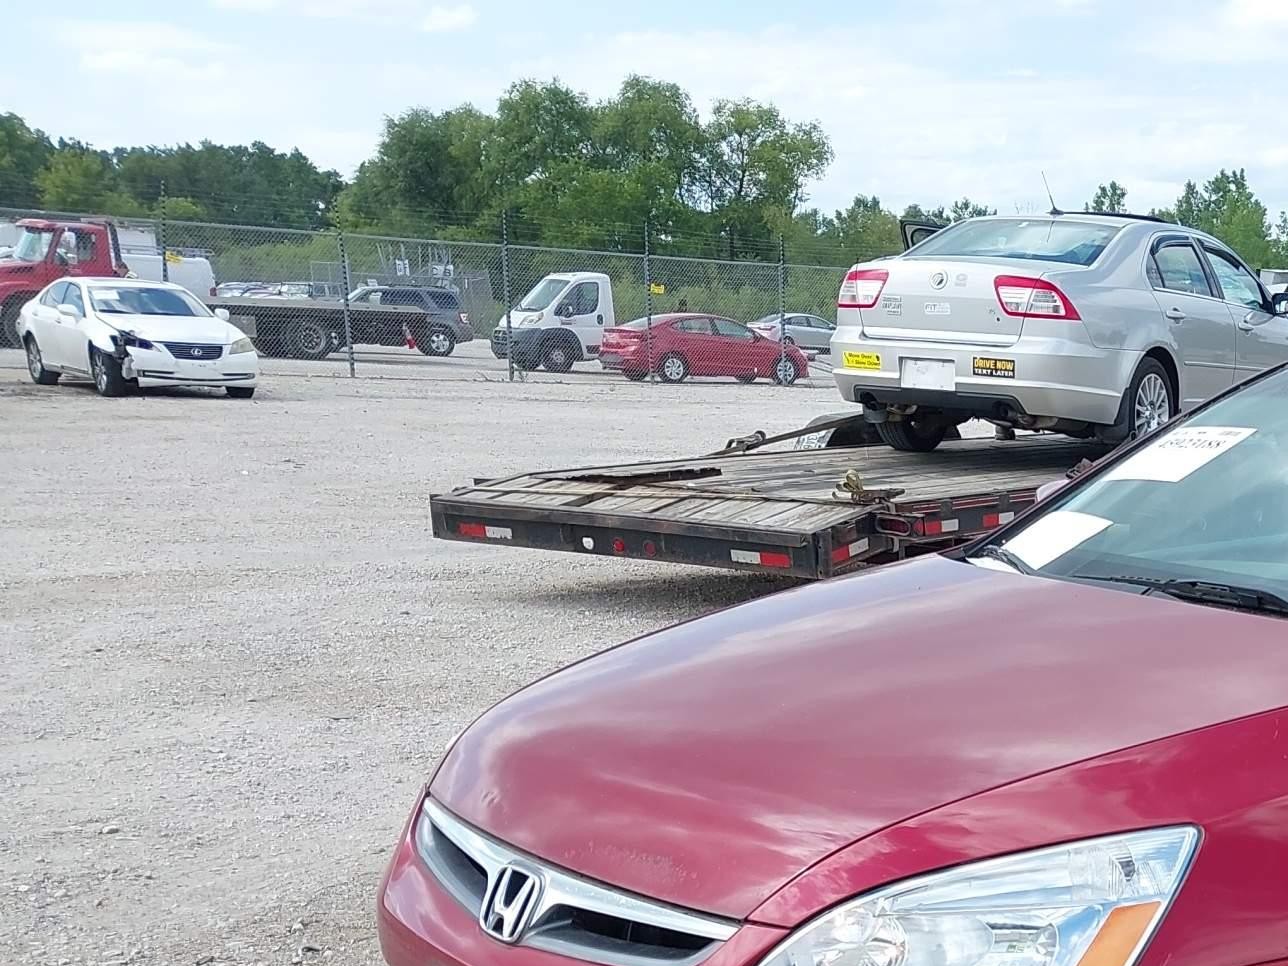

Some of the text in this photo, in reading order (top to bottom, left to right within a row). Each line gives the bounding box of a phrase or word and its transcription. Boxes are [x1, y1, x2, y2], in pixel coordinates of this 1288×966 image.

[974, 357, 1014, 371] DRIVE NOW
[992, 369, 1014, 377] LATER
